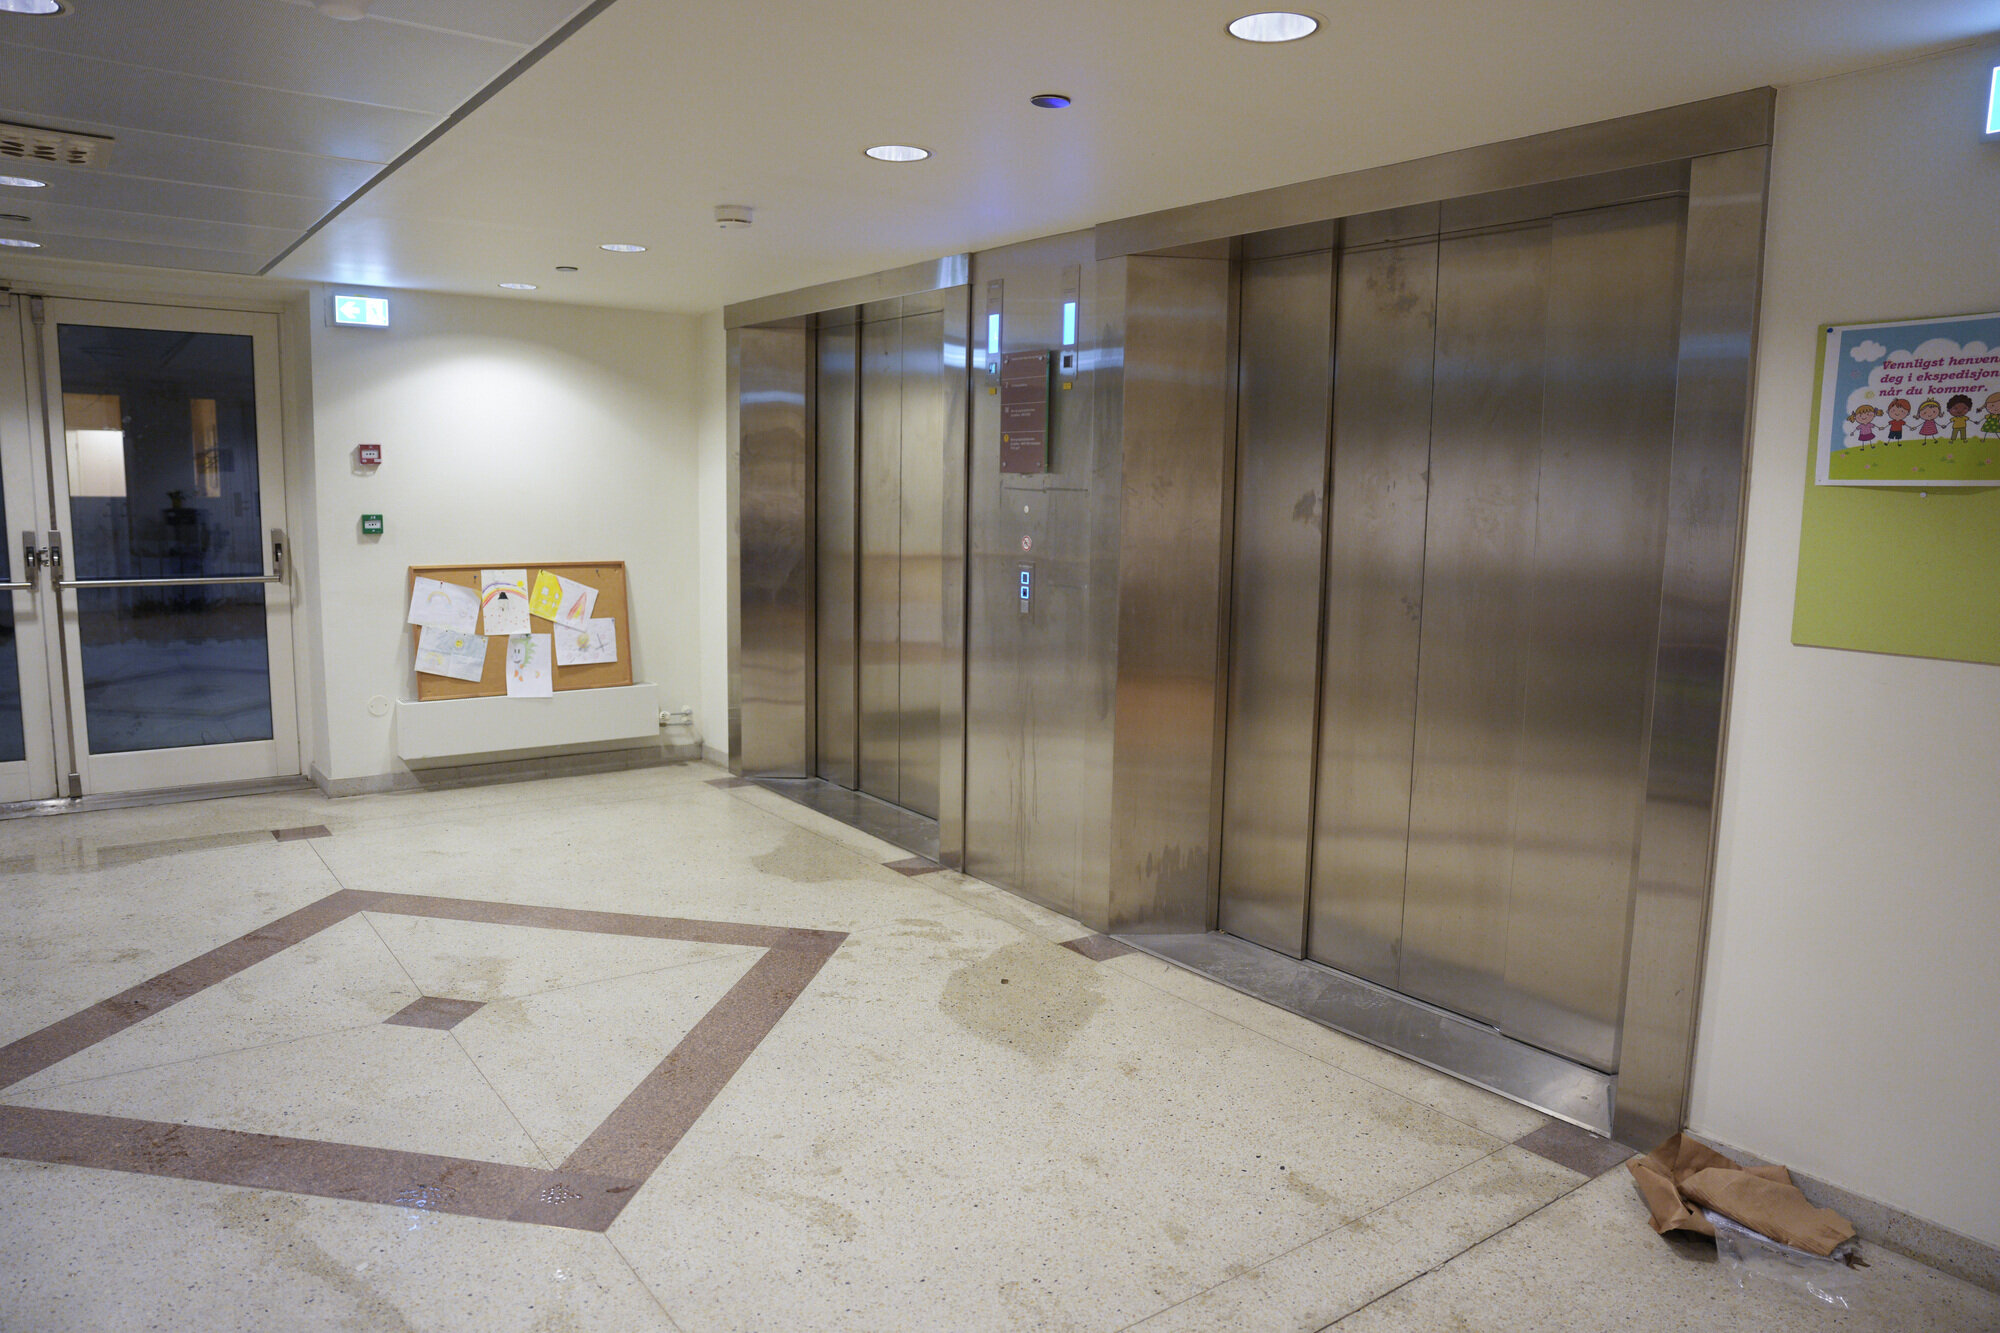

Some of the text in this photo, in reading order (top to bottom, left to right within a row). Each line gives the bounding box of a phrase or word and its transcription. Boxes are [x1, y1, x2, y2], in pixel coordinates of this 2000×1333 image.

[1883, 355, 2000, 370] Vennligst henven
[1880, 374, 1904, 385] deg
[1907, 373, 1913, 382] i
[1879, 384, 1988, 396] når du kommer.
